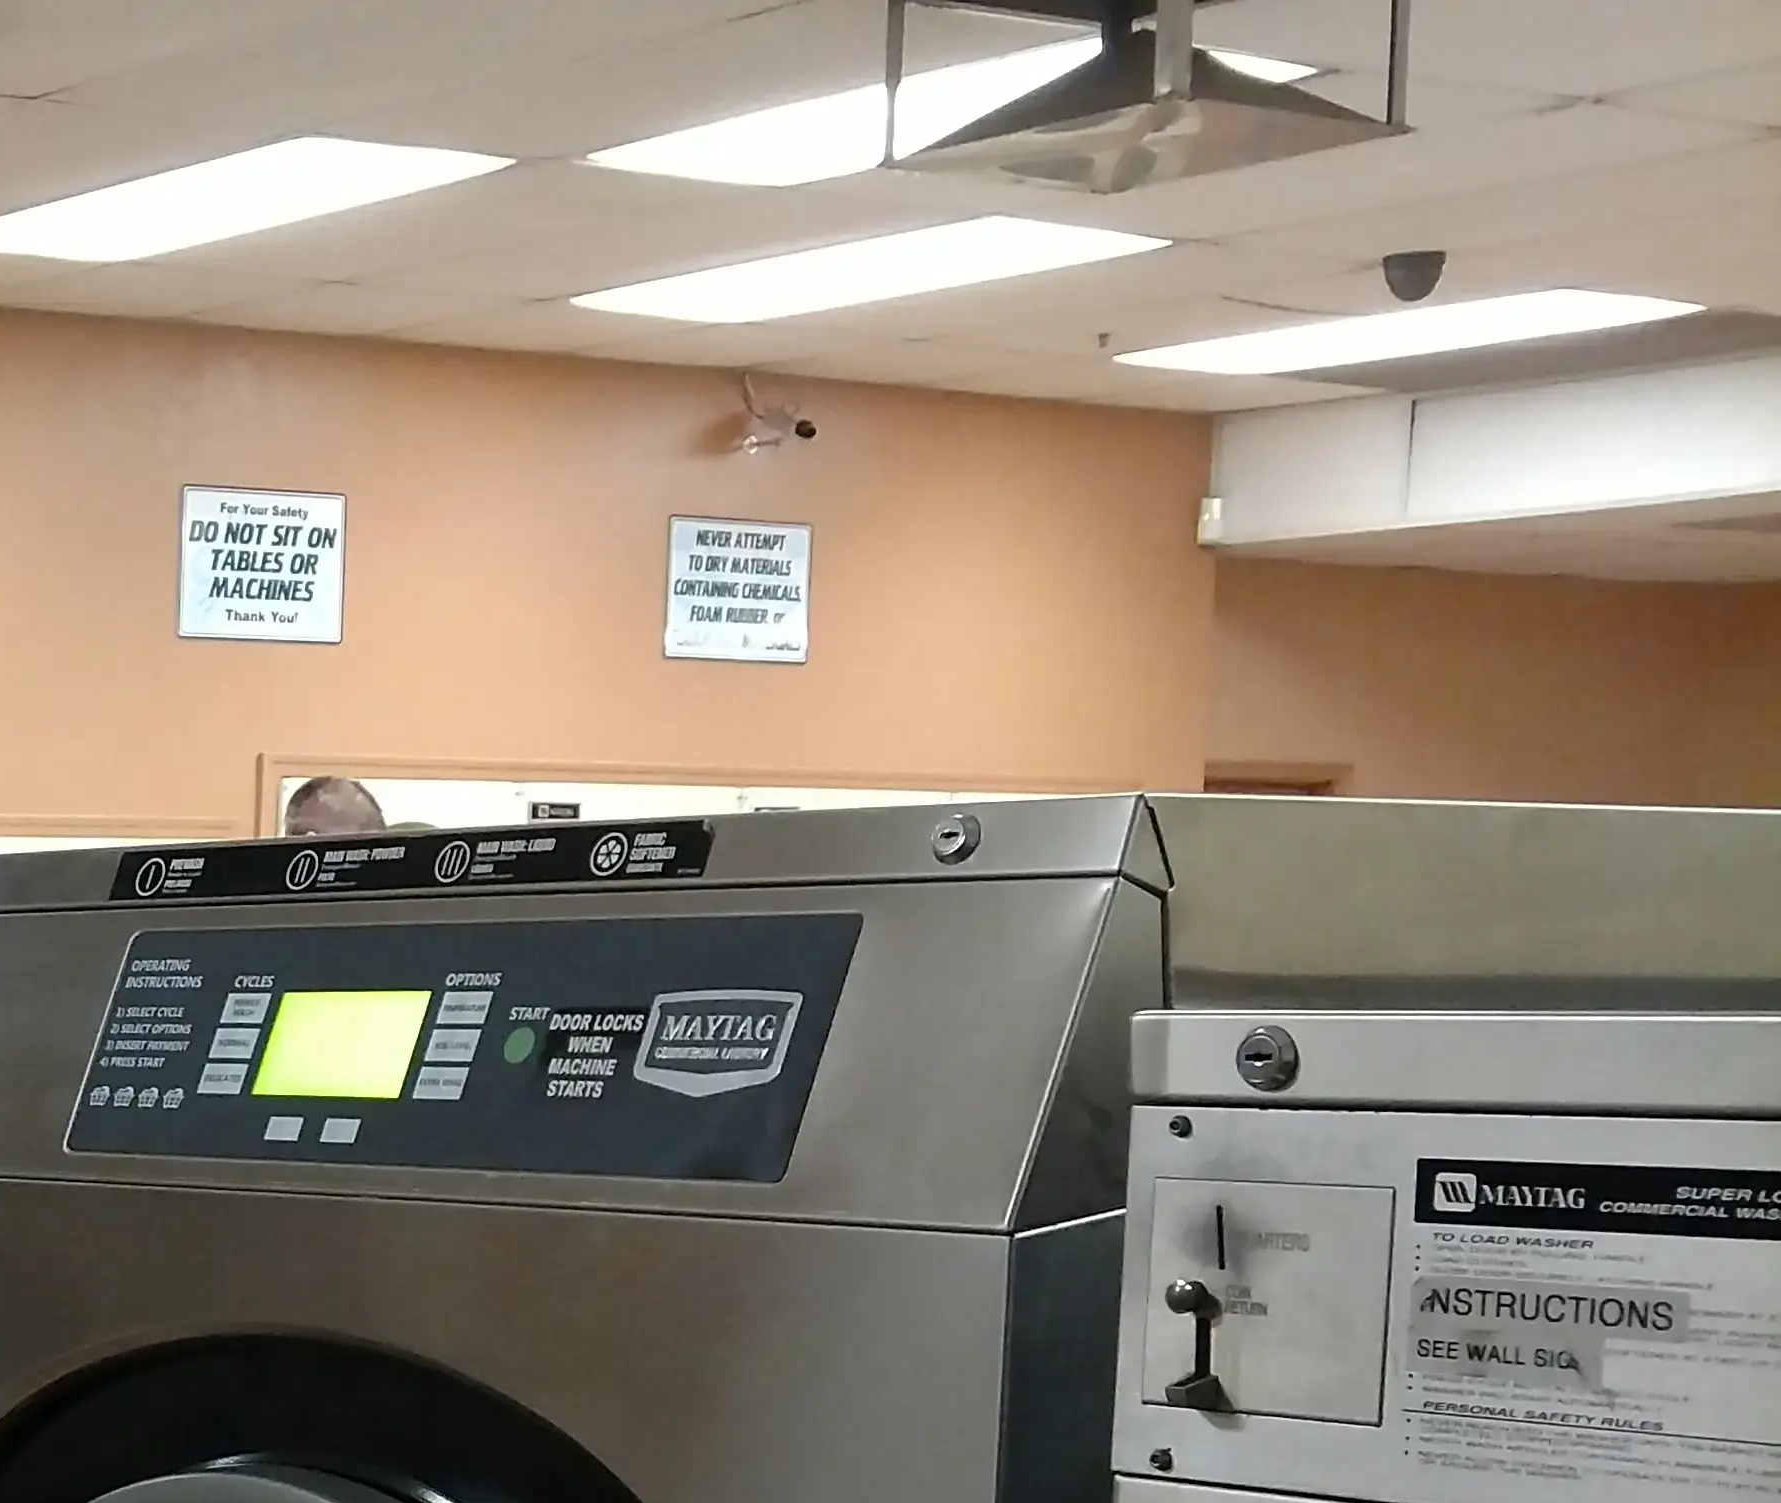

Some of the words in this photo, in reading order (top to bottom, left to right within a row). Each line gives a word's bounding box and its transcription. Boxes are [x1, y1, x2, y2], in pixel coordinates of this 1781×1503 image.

[220, 502, 239, 514] For
[243, 503, 269, 516] Your
[272, 505, 309, 521] Safety
[188, 520, 219, 543] DO
[224, 522, 268, 545] NOT
[271, 525, 303, 547] SIT
[307, 527, 337, 549] ON
[696, 530, 732, 548] NEVER
[734, 532, 786, 551] ATTEMPT
[211, 549, 285, 573] TABLES
[290, 553, 319, 575] OR
[689, 554, 703, 572] TO
[705, 555, 729, 573] DRY
[730, 557, 792, 576] MATERIALS
[208, 576, 315, 602] MACHINES
[673, 578, 739, 598] CONTAINING
[225, 609, 265, 622] Thank
[271, 611, 298, 624] You!
[689, 605, 723, 623] FOAM
[131, 959, 192, 972] OPERATING
[125, 975, 203, 989] INSTRUCTIONS
[234, 975, 275, 988] CYCLES
[445, 972, 502, 987] OPTIONS
[509, 1006, 551, 1021] START
[152, 1023, 192, 1035] OPTIONS
[549, 1014, 592, 1031] DOOR
[593, 1014, 645, 1032] LOCKS
[659, 1014, 777, 1041] MAYTAG
[567, 1036, 614, 1053] WHEN
[138, 1057, 166, 1068] START
[548, 1058, 617, 1076] MACHINE
[546, 1080, 604, 1098] STARTS
[1480, 1184, 1586, 1210] MAYTAG
[1676, 1186, 1753, 1202] SUPER
[1599, 1201, 1729, 1218] COMMERCIAL
[1736, 1207, 1781, 1221] WAS
[1433, 1232, 1455, 1242] TO
[1460, 1233, 1510, 1245] LOAD
[1515, 1237, 1594, 1249] WASHER
[1416, 1338, 1460, 1360] SEE
[1466, 1342, 1527, 1366] WALL
[1422, 1400, 1518, 1418] PERSONAL
[1523, 1409, 1597, 1425] SAFETY
[1600, 1417, 1664, 1431] RULES
